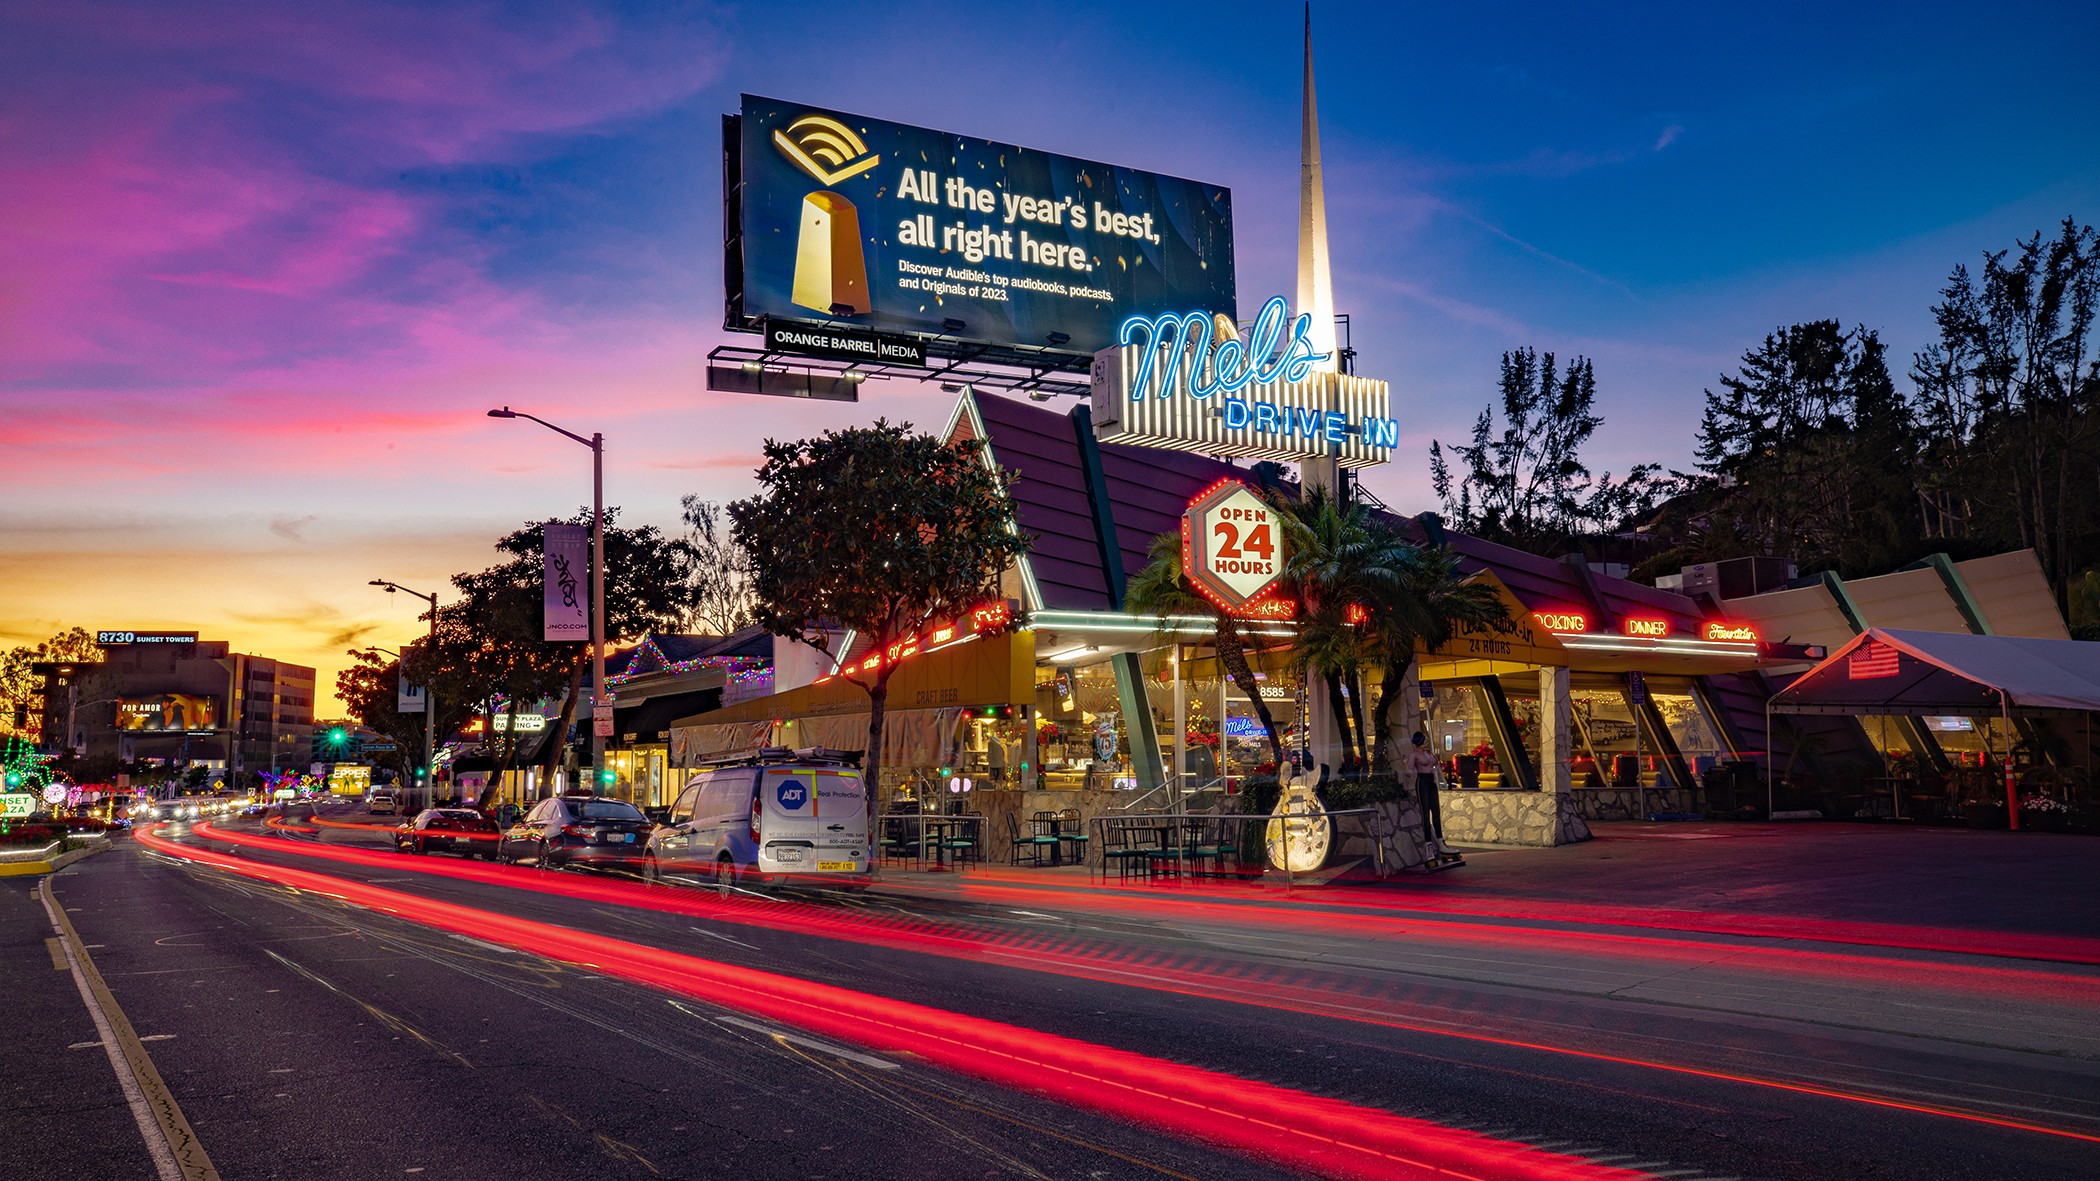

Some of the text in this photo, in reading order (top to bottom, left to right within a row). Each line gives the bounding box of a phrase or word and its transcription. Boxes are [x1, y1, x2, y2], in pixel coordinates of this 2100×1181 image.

[897, 167, 1160, 245] All the year’s best,
[898, 214, 1092, 271] all right here.
[898, 259, 944, 278] Discover
[992, 273, 1009, 287] top
[1010, 277, 1068, 296] audiobooks,
[1069, 286, 1114, 302] podcasts,
[898, 275, 1009, 301] and Originals of 2023.
[774, 331, 919, 359] ORANGE BARREL MEDIA
[1120, 295, 1332, 400] Mels
[1220, 507, 1267, 523] OPEN
[1214, 521, 1275, 560] 24
[1215, 559, 1273, 575] HOURS
[1630, 620, 1666, 635] DINNER
[1708, 623, 1757, 641] Fountain
[100, 632, 135, 643] 8730
[1470, 639, 1511, 655] 24 HOURS
[916, 688, 958, 705] CRAFT BEER
[1260, 687, 1284, 697] 8585
[122, 704, 161, 712] POR AMOR
[1226, 719, 1252, 734] Mels
[782, 790, 803, 800] ADT
